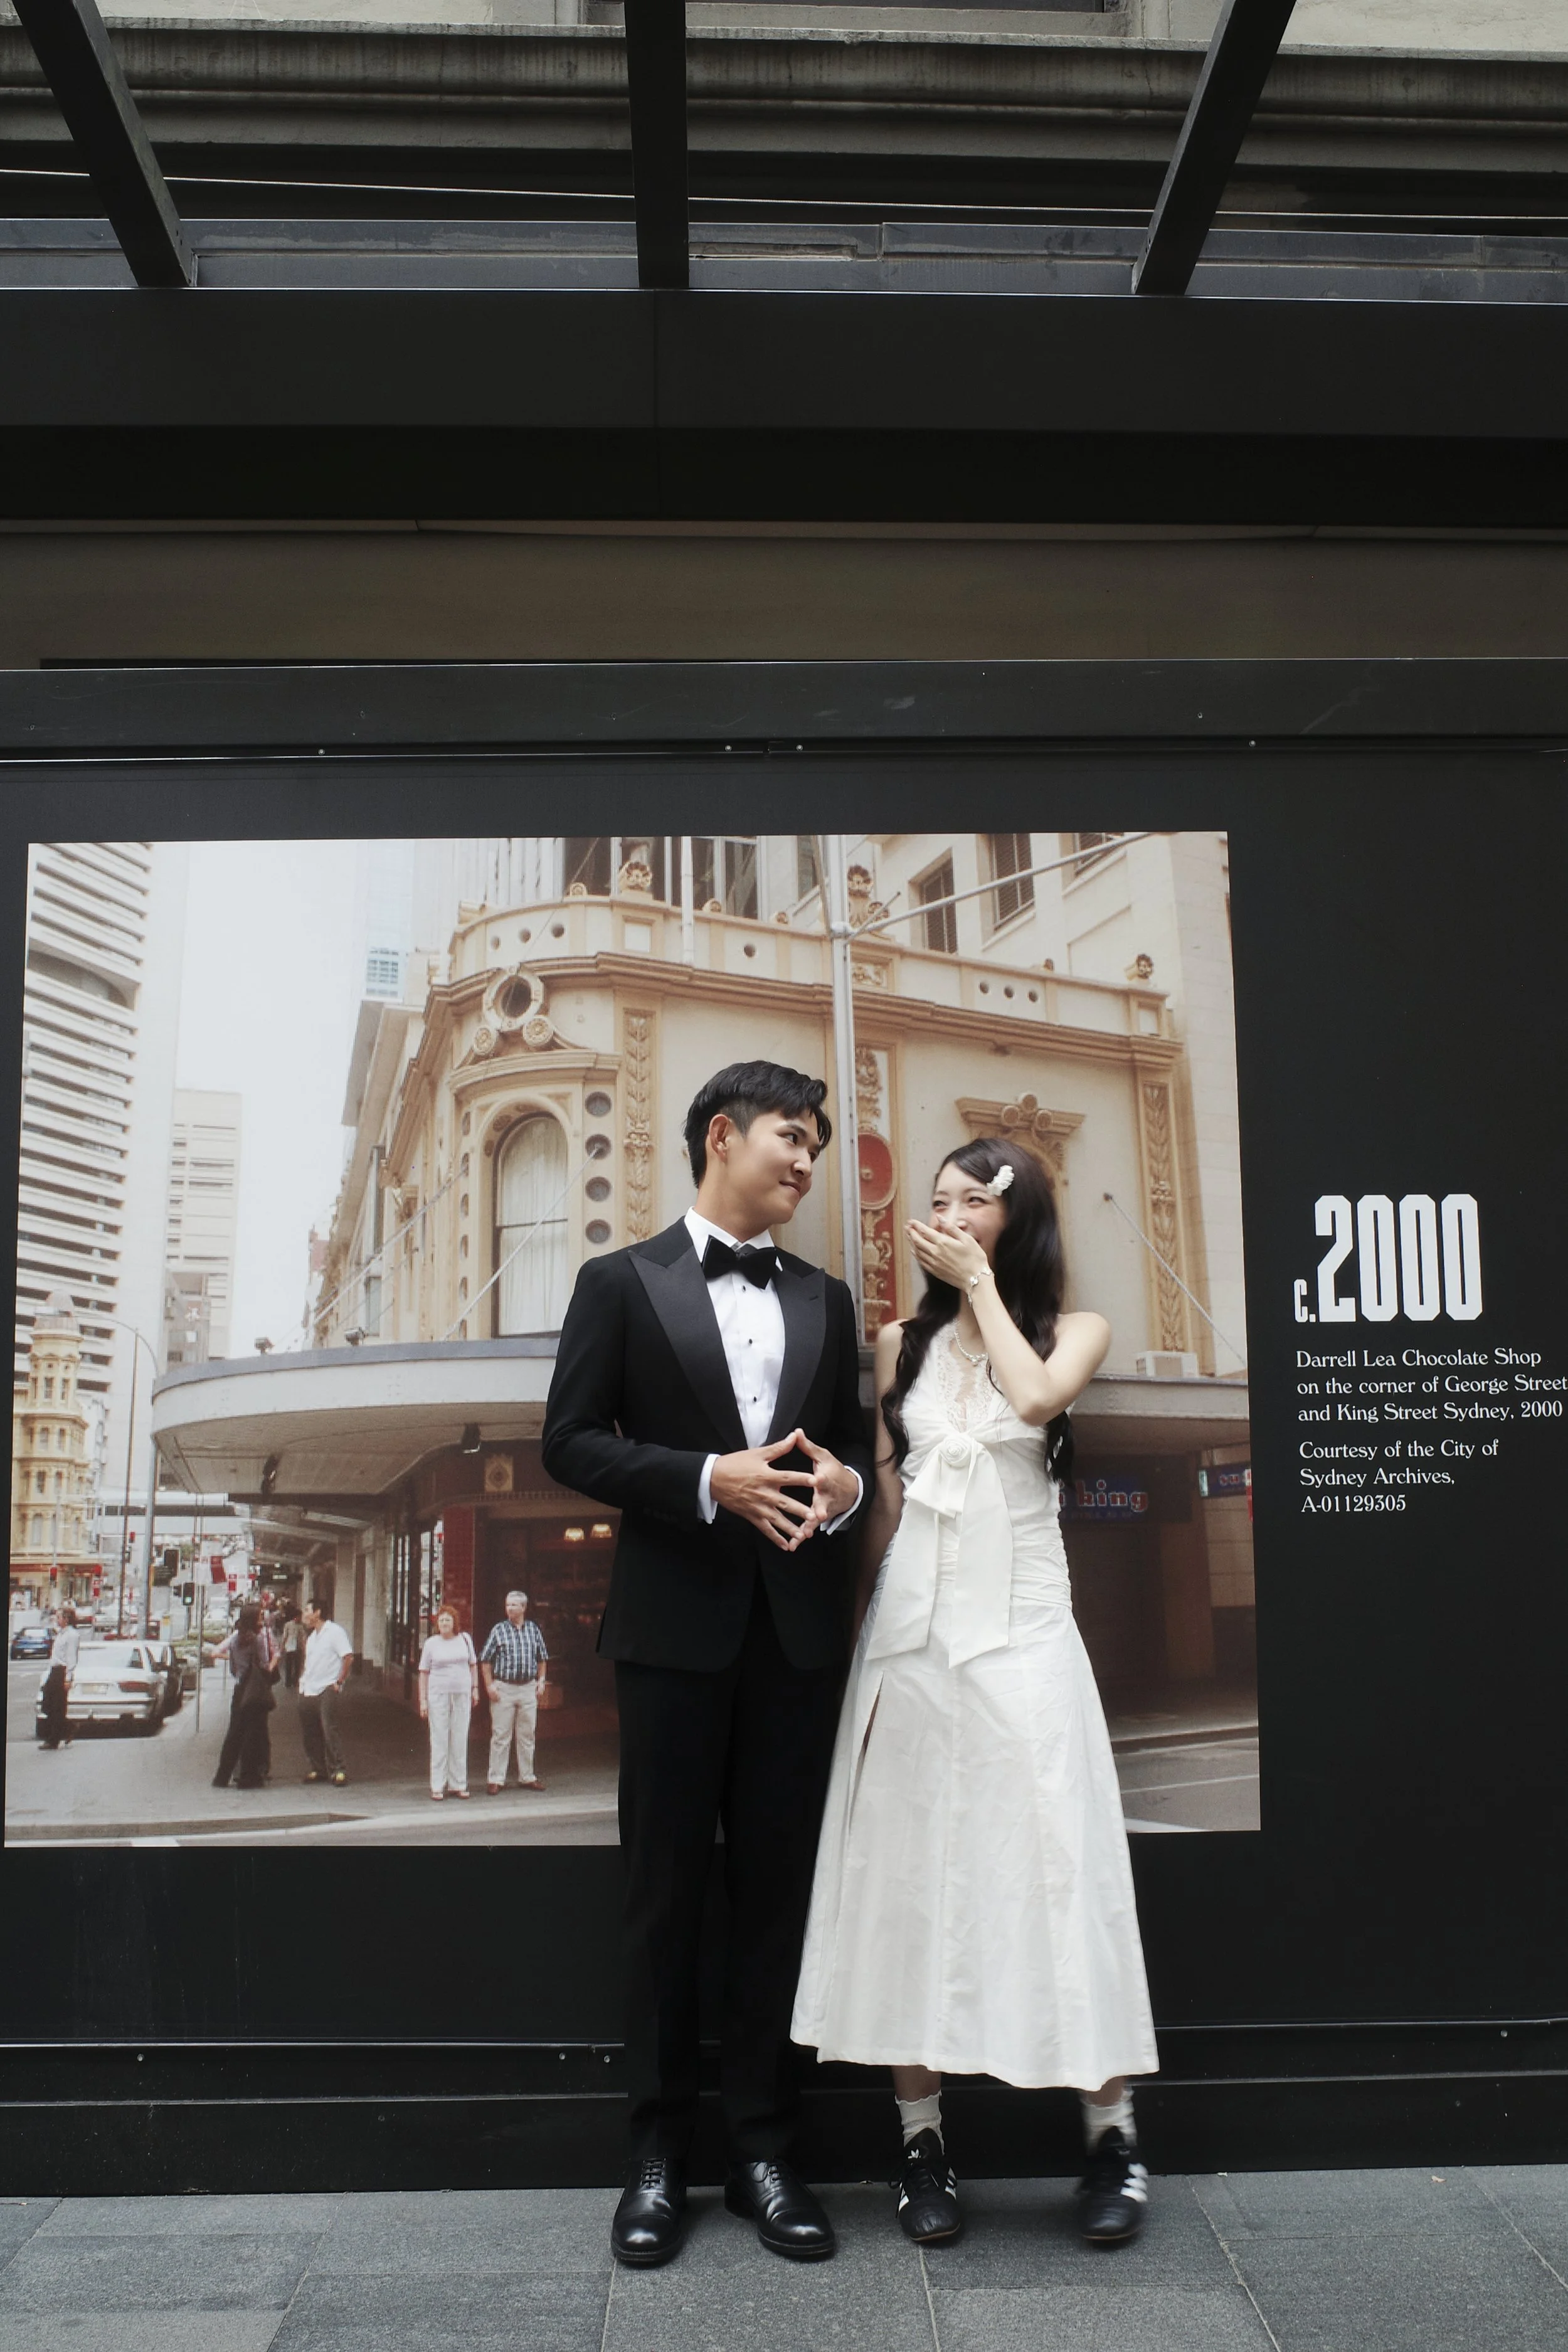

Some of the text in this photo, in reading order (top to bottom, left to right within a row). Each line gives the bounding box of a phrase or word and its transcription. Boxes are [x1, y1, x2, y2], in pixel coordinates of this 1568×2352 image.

[1296, 1348, 1541, 1367] Darrell Lea Chocolate Shop
[1298, 1374, 1568, 1394] on the corner of George Street
[1298, 1401, 1562, 1423] and King Street Sydney, 2000
[1300, 1439, 1498, 1460] Courtesy of the City of
[1300, 1468, 1454, 1488] Sydney Archives,
[1301, 1495, 1406, 1512] A-01129305
